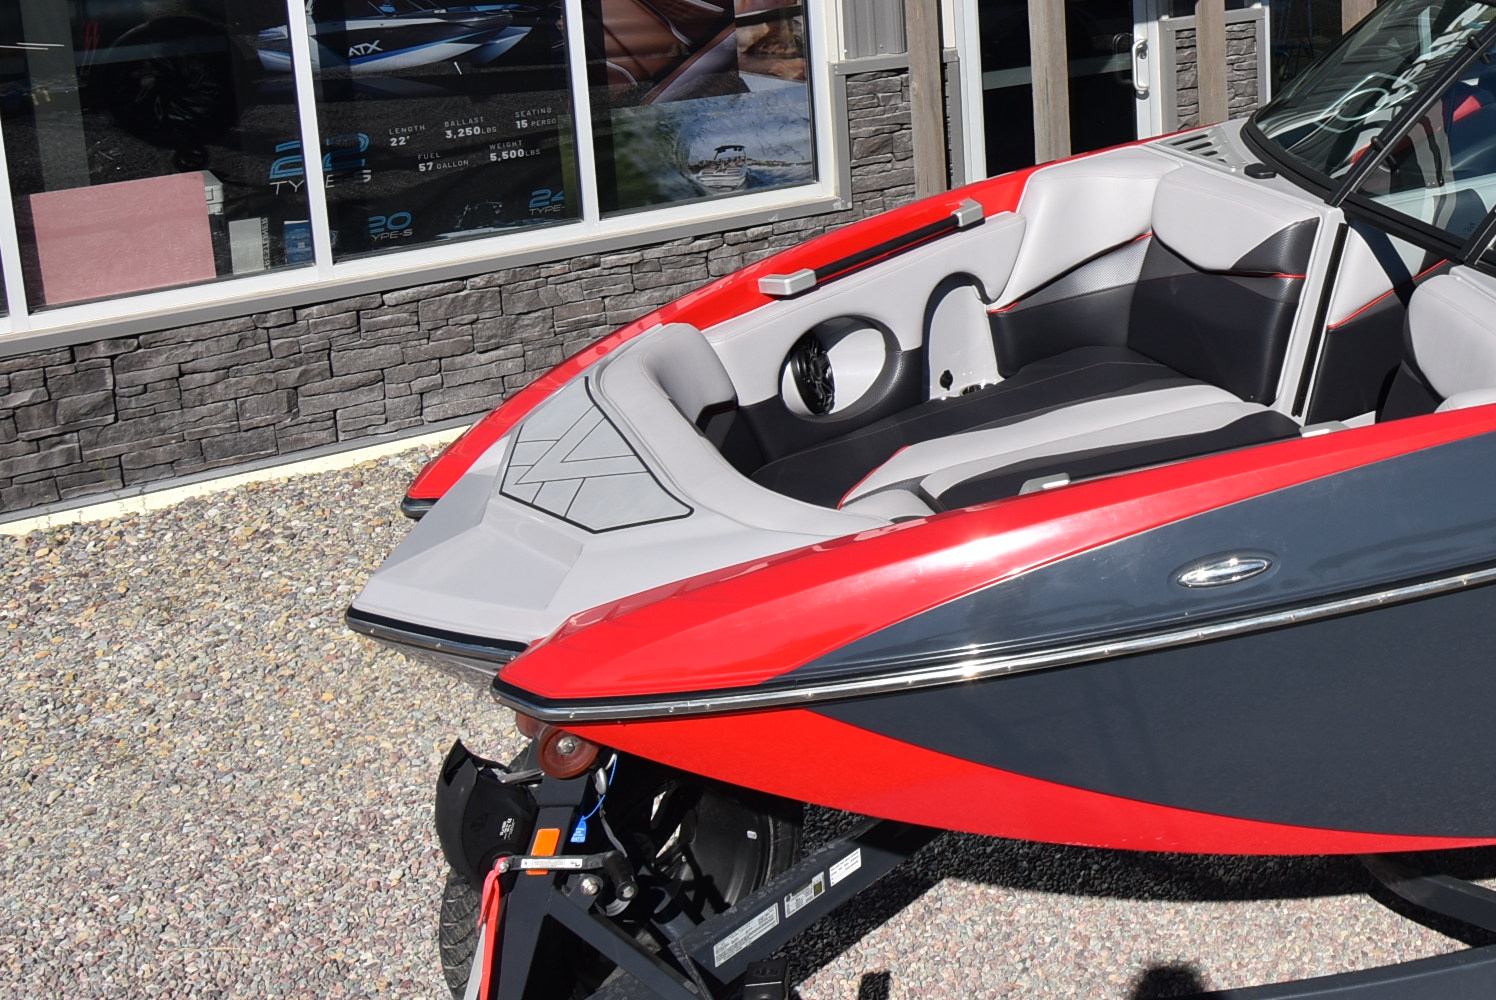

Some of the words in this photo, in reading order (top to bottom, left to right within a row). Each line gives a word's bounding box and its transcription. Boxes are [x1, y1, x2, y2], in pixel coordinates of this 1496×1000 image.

[348, 40, 384, 57] ATX
[514, 106, 553, 118] SEATING
[444, 115, 485, 128] BALLAST
[515, 118, 529, 129] 15
[530, 116, 558, 127] PERSO
[388, 123, 426, 135] LENGTH
[489, 139, 523, 150] WEIGHT
[418, 152, 441, 161] FUEL
[418, 161, 434, 172] 57
[436, 159, 469, 171] GALLON
[368, 211, 412, 234] 20
[371, 228, 413, 241] YPE-S
